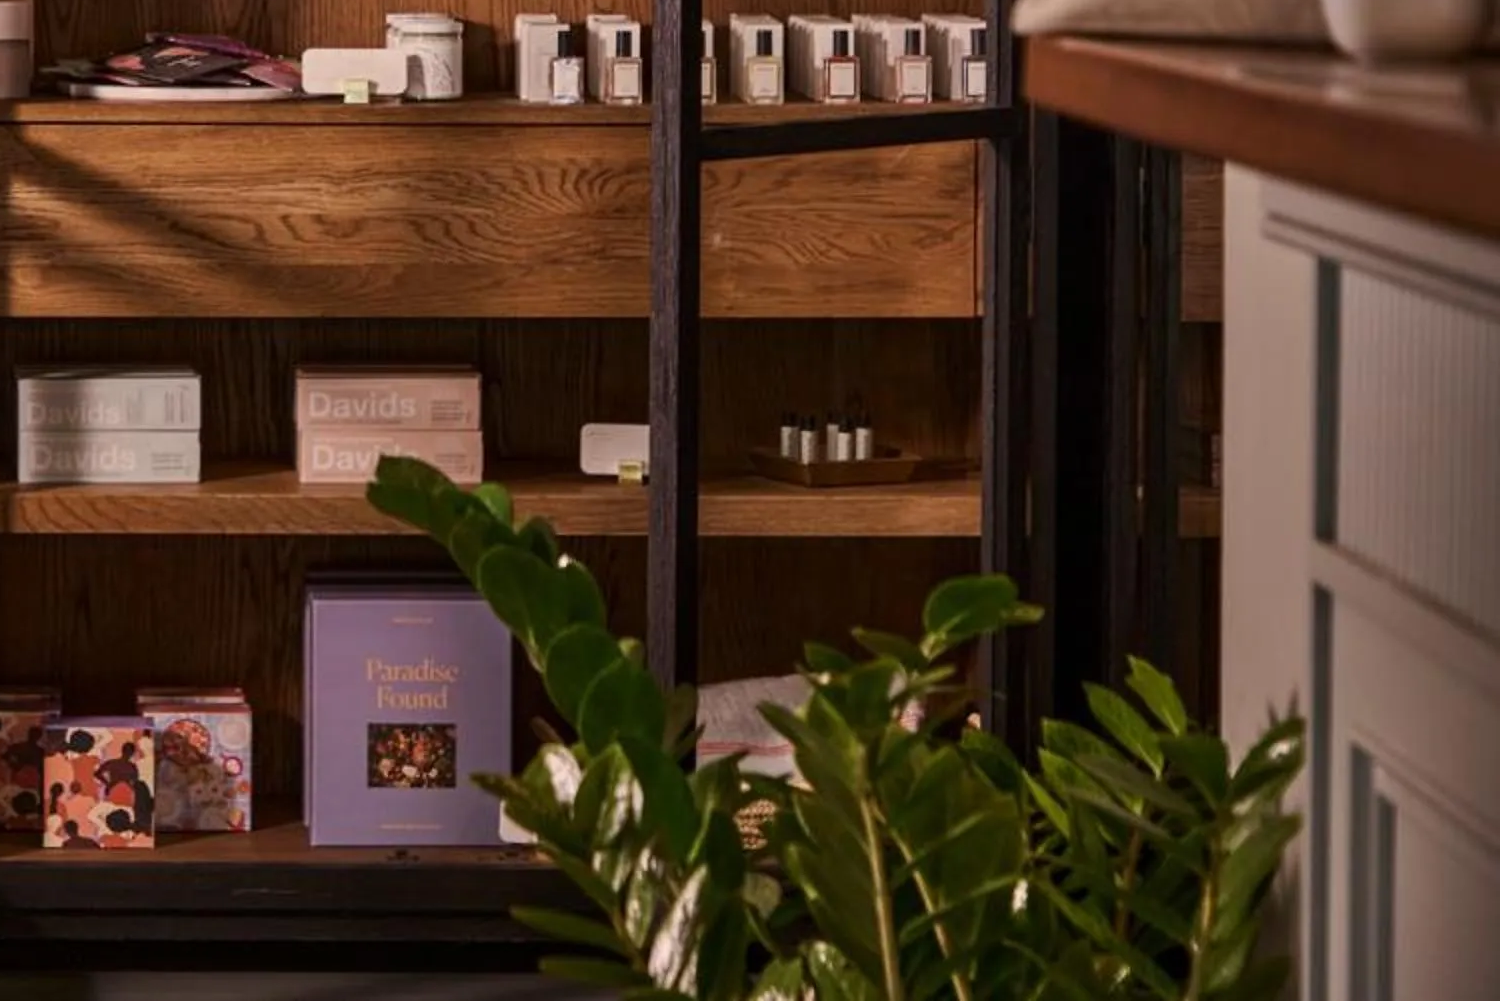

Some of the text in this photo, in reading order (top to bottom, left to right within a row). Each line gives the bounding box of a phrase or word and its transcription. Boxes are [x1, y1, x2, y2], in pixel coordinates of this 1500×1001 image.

[26, 401, 121, 425] Davids
[309, 390, 416, 418] Davids
[32, 444, 136, 472] Davids
[312, 443, 418, 471] Davi
[367, 657, 459, 683] Paradise
[377, 684, 448, 710] Found
